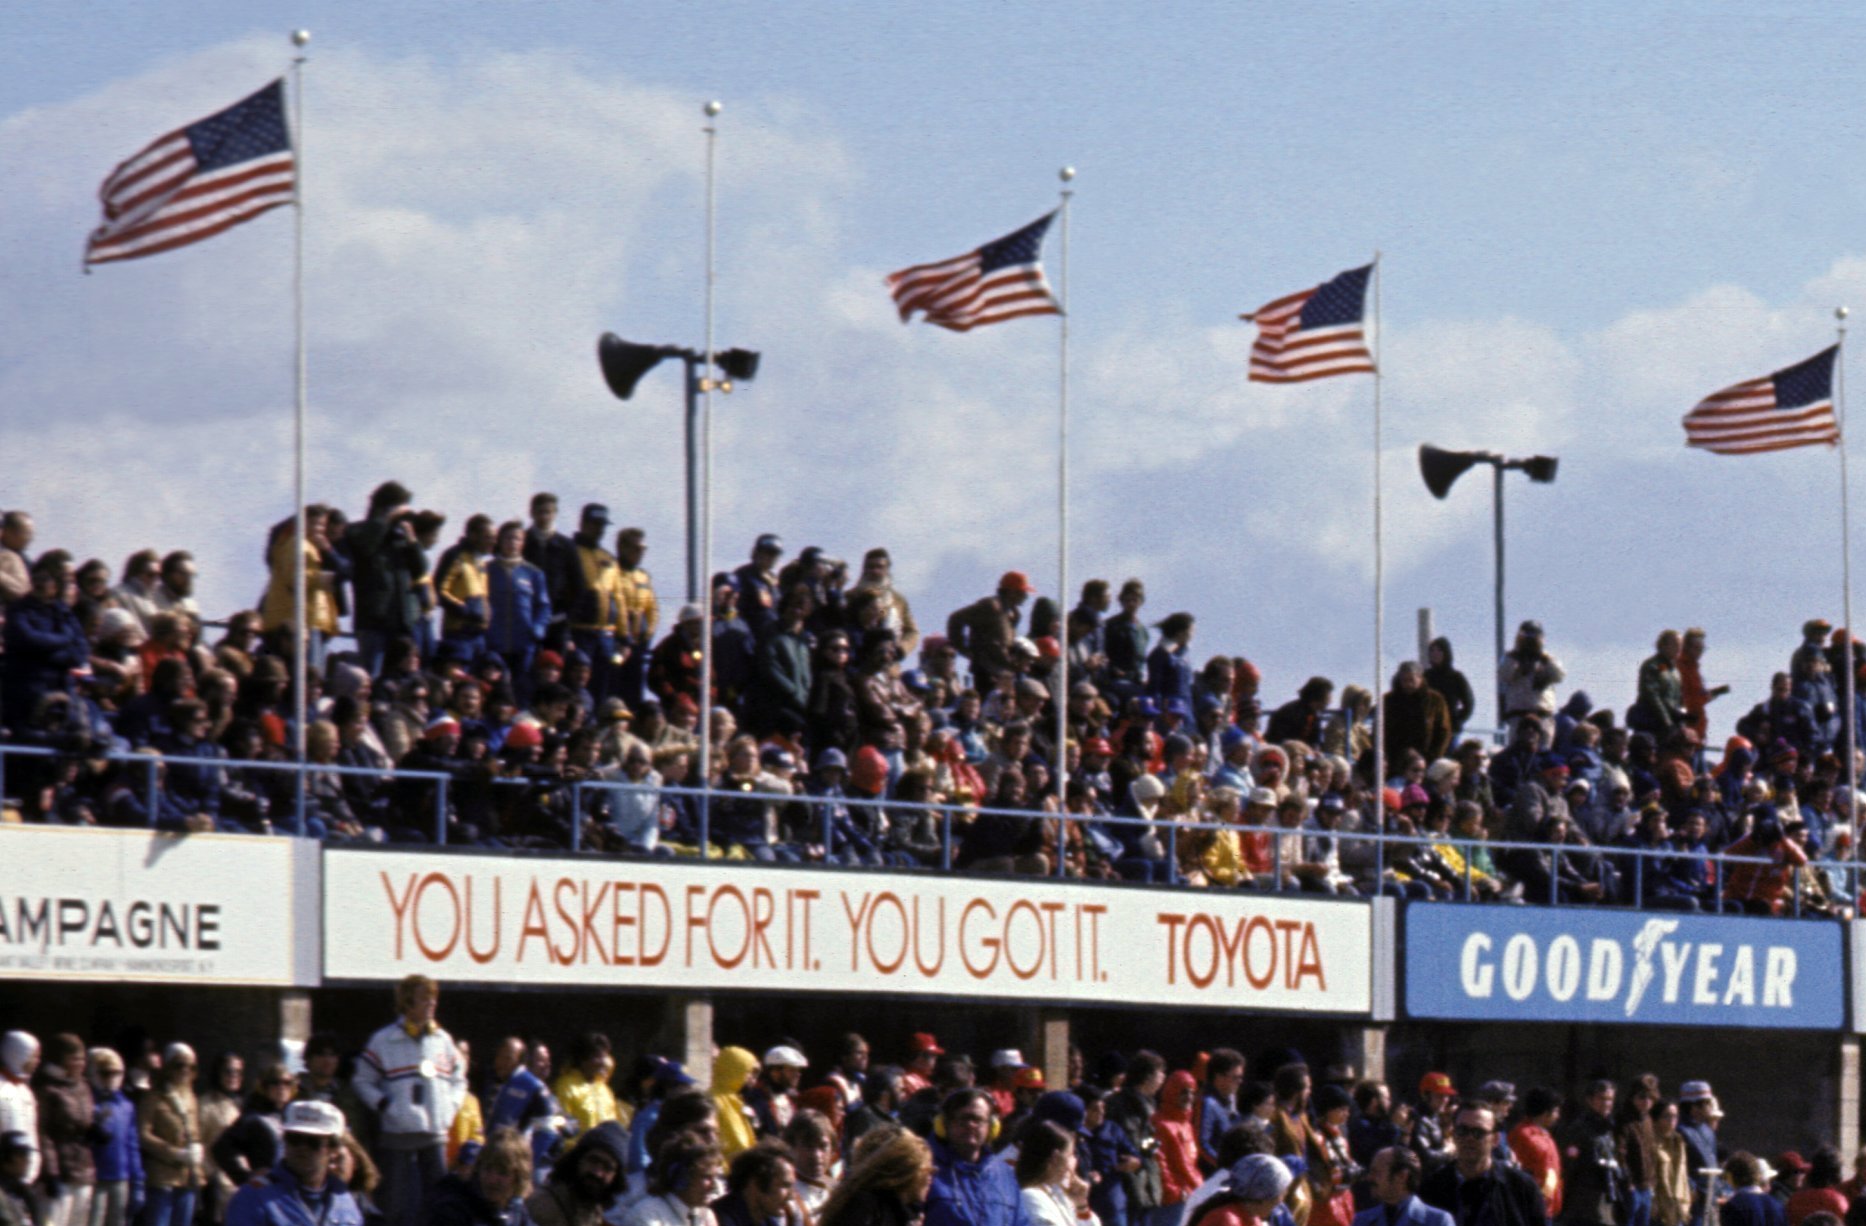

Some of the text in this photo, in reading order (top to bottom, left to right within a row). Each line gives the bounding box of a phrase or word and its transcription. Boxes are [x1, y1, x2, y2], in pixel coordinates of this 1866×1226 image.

[380, 871, 1327, 992] YOU ASKED FOR IT. YOU GOT IT. TOYOTA
[1460, 930, 1798, 1009] GOODYEAR
